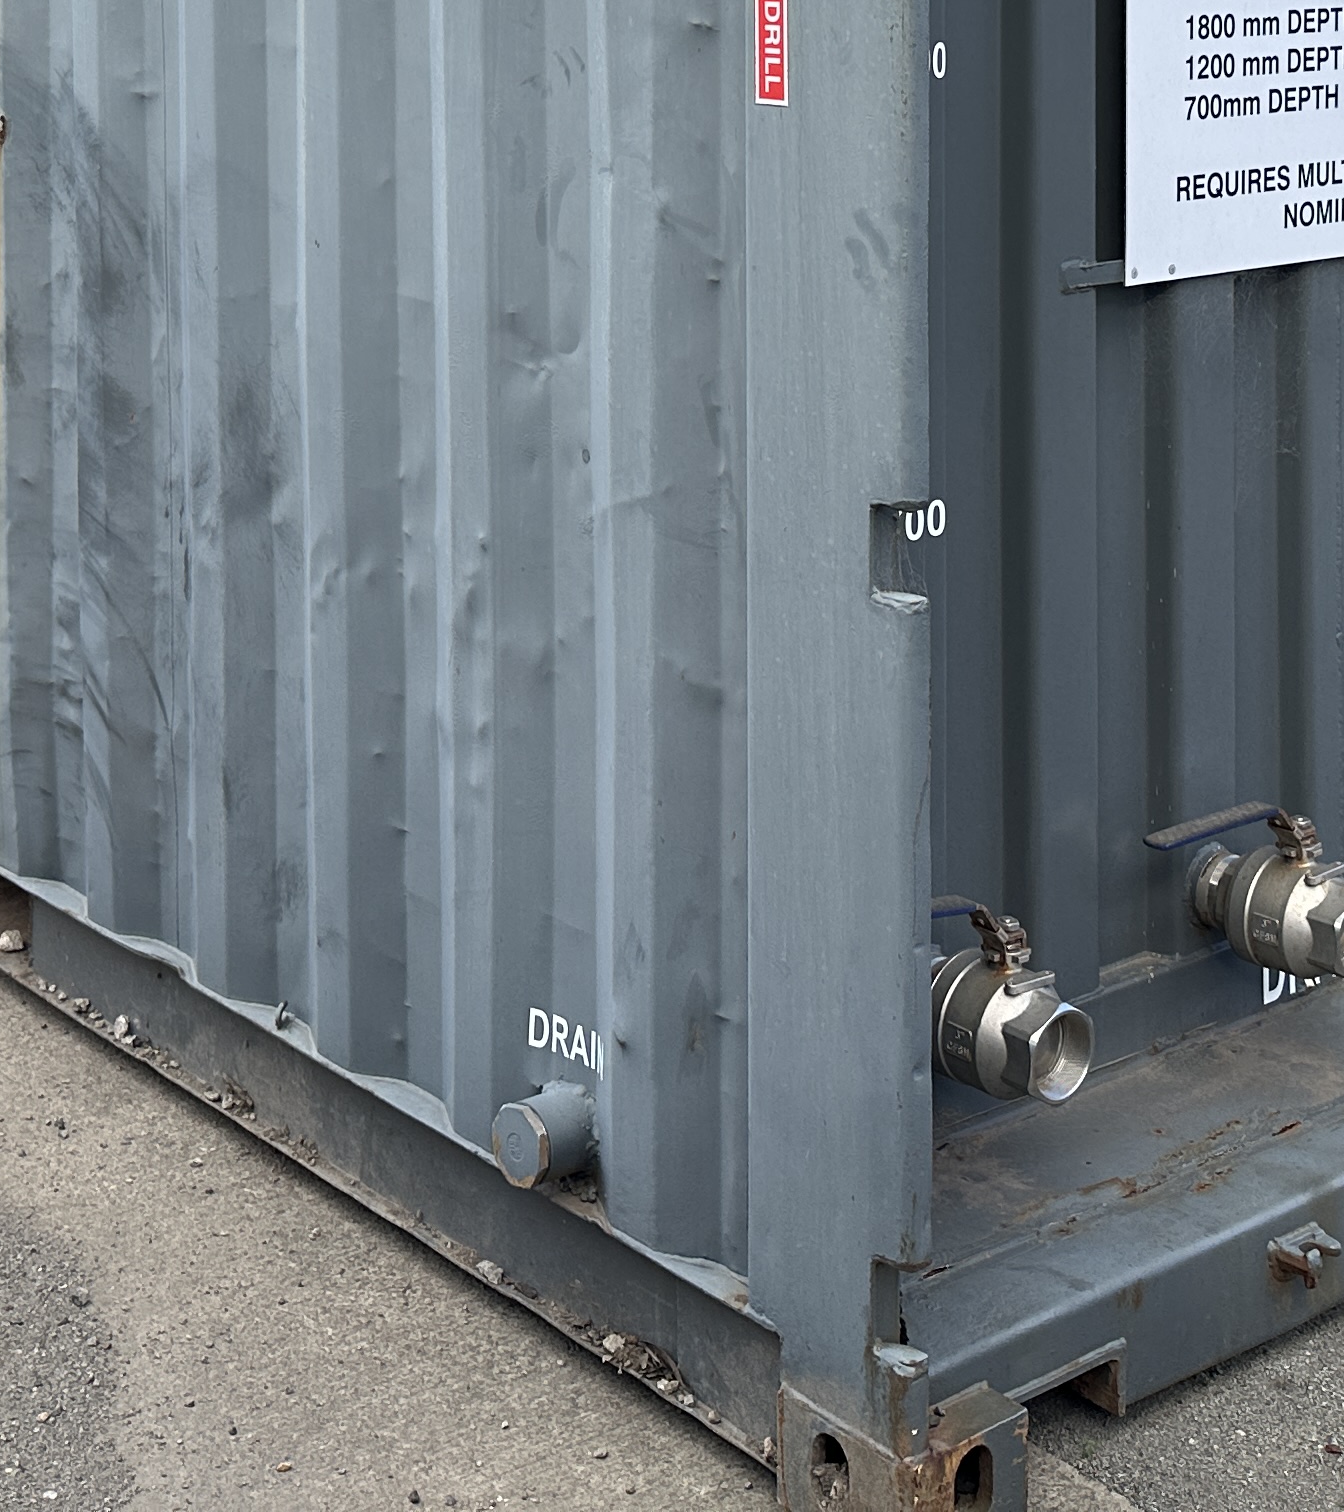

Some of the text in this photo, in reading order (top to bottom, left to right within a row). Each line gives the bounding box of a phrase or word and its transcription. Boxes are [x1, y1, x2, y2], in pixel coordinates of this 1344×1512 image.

[1185, 13, 1236, 40] 1800
[1243, 16, 1280, 37] mm
[764, 0, 782, 93] DRILL
[1185, 52, 1235, 81] 1200
[1242, 55, 1279, 77] mm
[1184, 93, 1261, 121] 700mm
[1268, 83, 1339, 114] DEPTH
[1176, 164, 1291, 202] REQUIRES
[904, 499, 946, 542] 00
[527, 1006, 605, 1082] DRAIN
